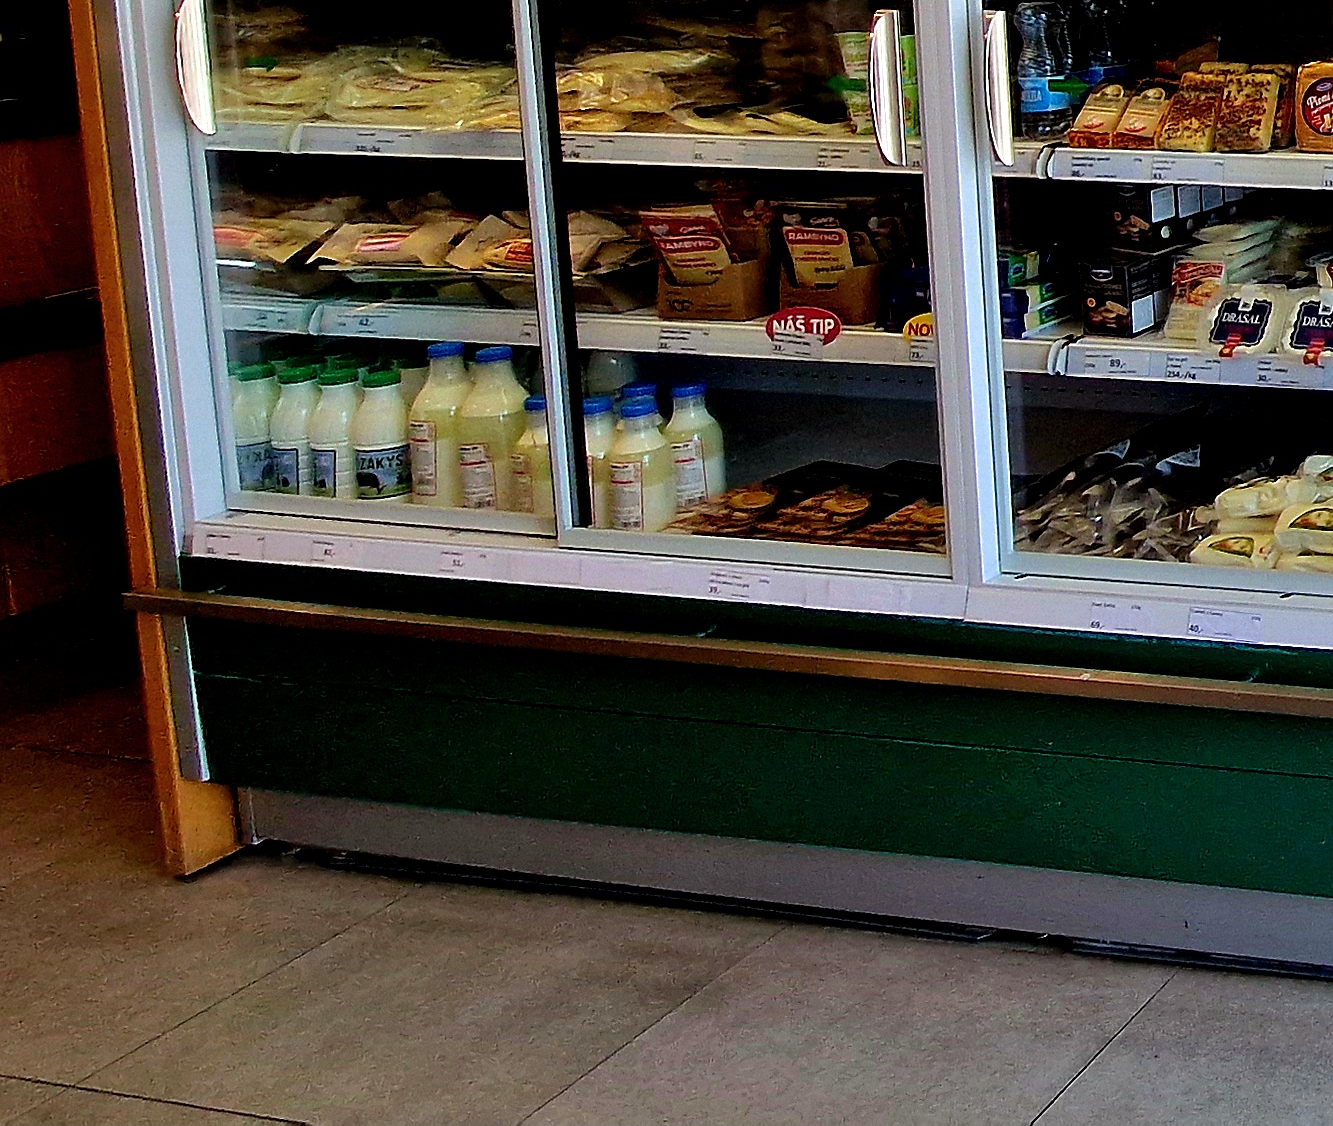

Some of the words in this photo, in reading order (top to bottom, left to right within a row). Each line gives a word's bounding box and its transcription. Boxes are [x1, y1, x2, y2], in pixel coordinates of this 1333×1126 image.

[772, 314, 806, 335] NÁŠ
[810, 319, 835, 335] TIP
[1222, 310, 1261, 325] DRÁSAL
[907, 322, 934, 337] NO
[1109, 359, 1126, 369] 89,-
